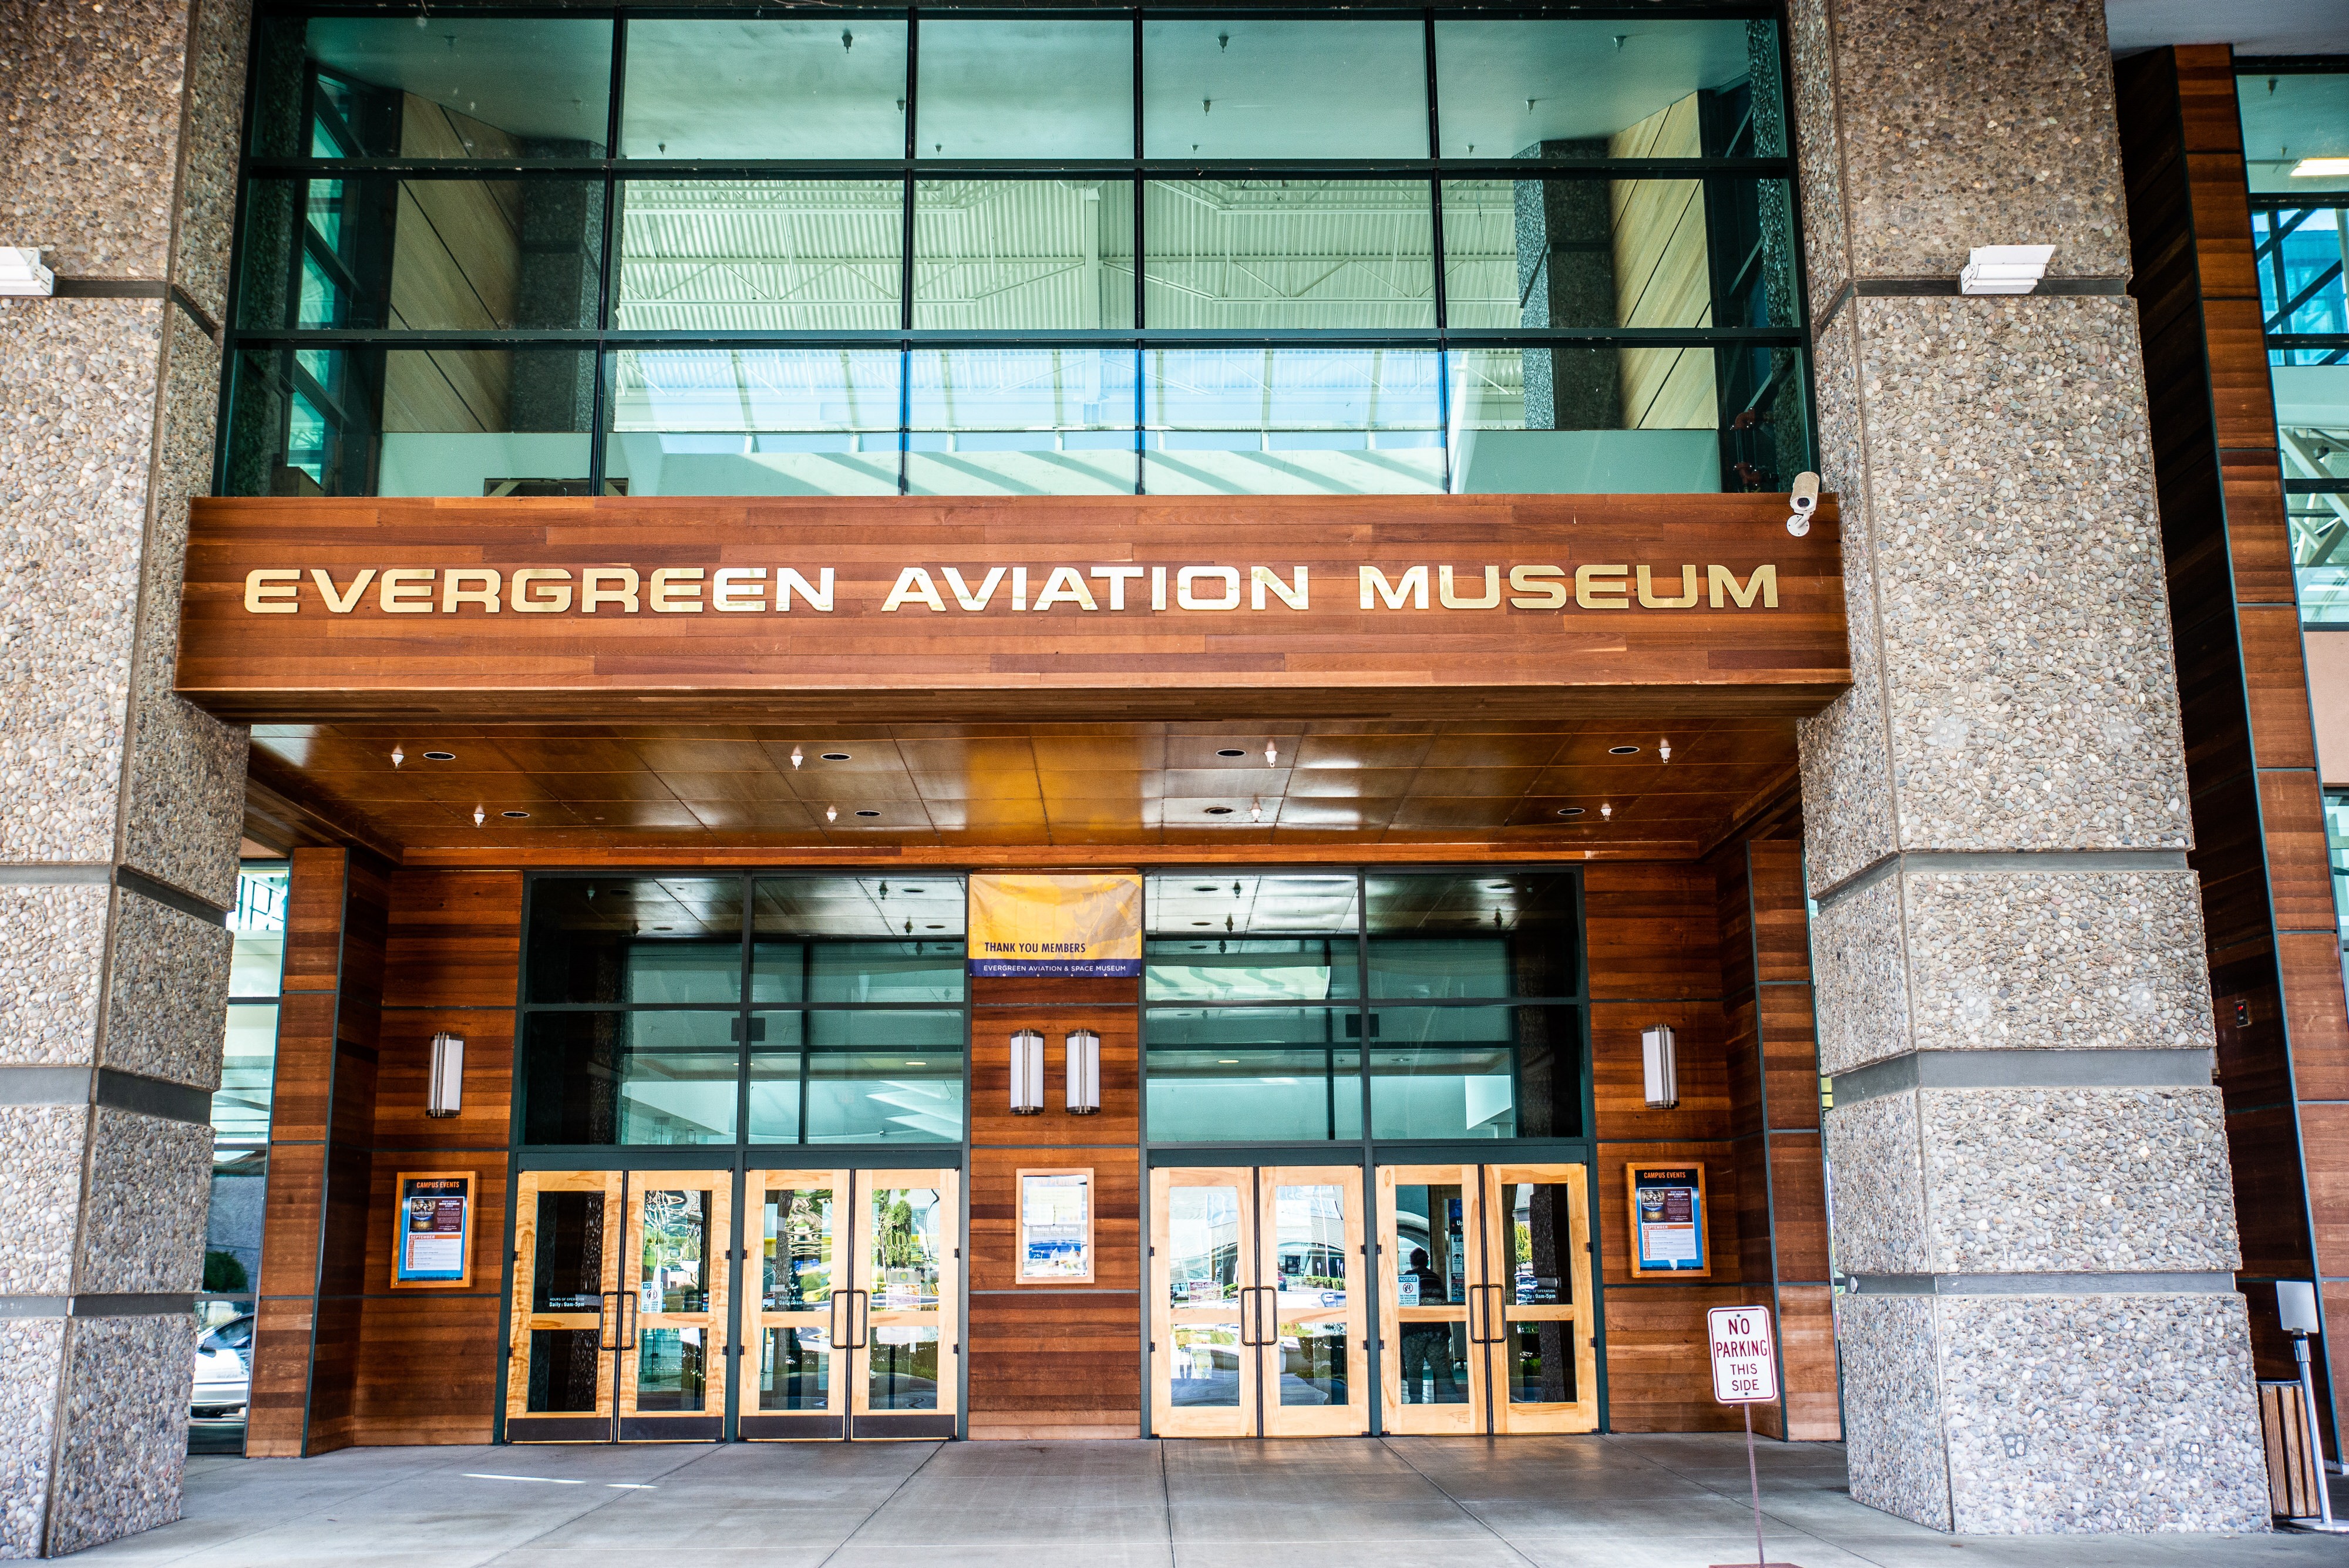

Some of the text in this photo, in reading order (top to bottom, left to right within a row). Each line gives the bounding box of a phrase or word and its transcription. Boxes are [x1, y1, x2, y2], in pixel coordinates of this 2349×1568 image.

[244, 564, 1778, 613] EVERGREEN AVIATION MUSEUM
[984, 942, 1086, 953] THANK YOU MEMBERS
[1728, 1318, 1750, 1335] NO
[1715, 1340, 1768, 1358] PARKING
[1730, 1363, 1758, 1375] THIS
[1732, 1379, 1759, 1392] SIDE
